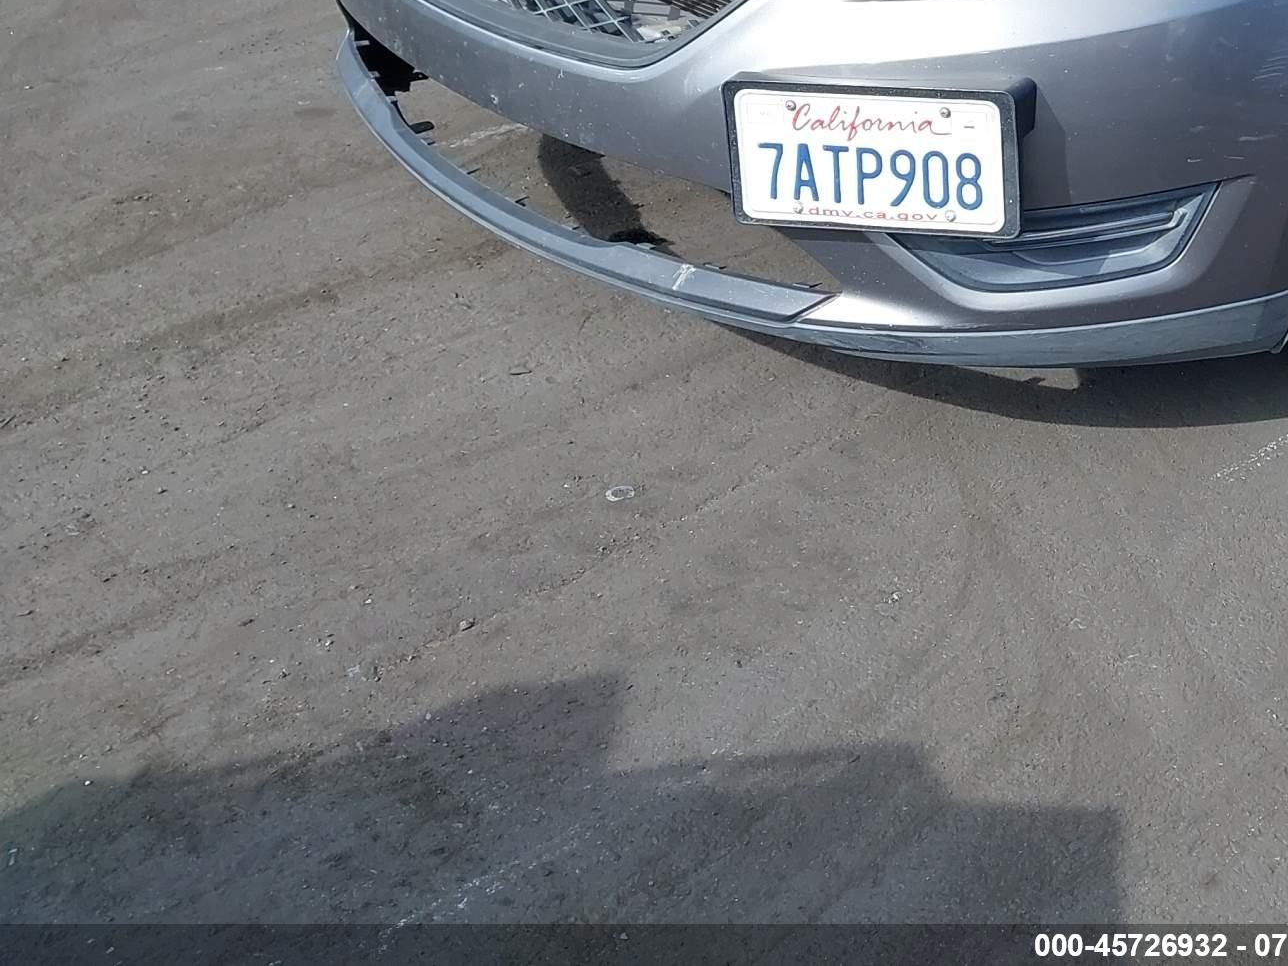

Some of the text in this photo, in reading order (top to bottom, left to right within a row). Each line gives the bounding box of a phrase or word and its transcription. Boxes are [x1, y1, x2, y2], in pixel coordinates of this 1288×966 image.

[791, 103, 952, 141] California
[758, 142, 983, 210] 7ATP908
[808, 206, 938, 221] dmv.ca.gov
